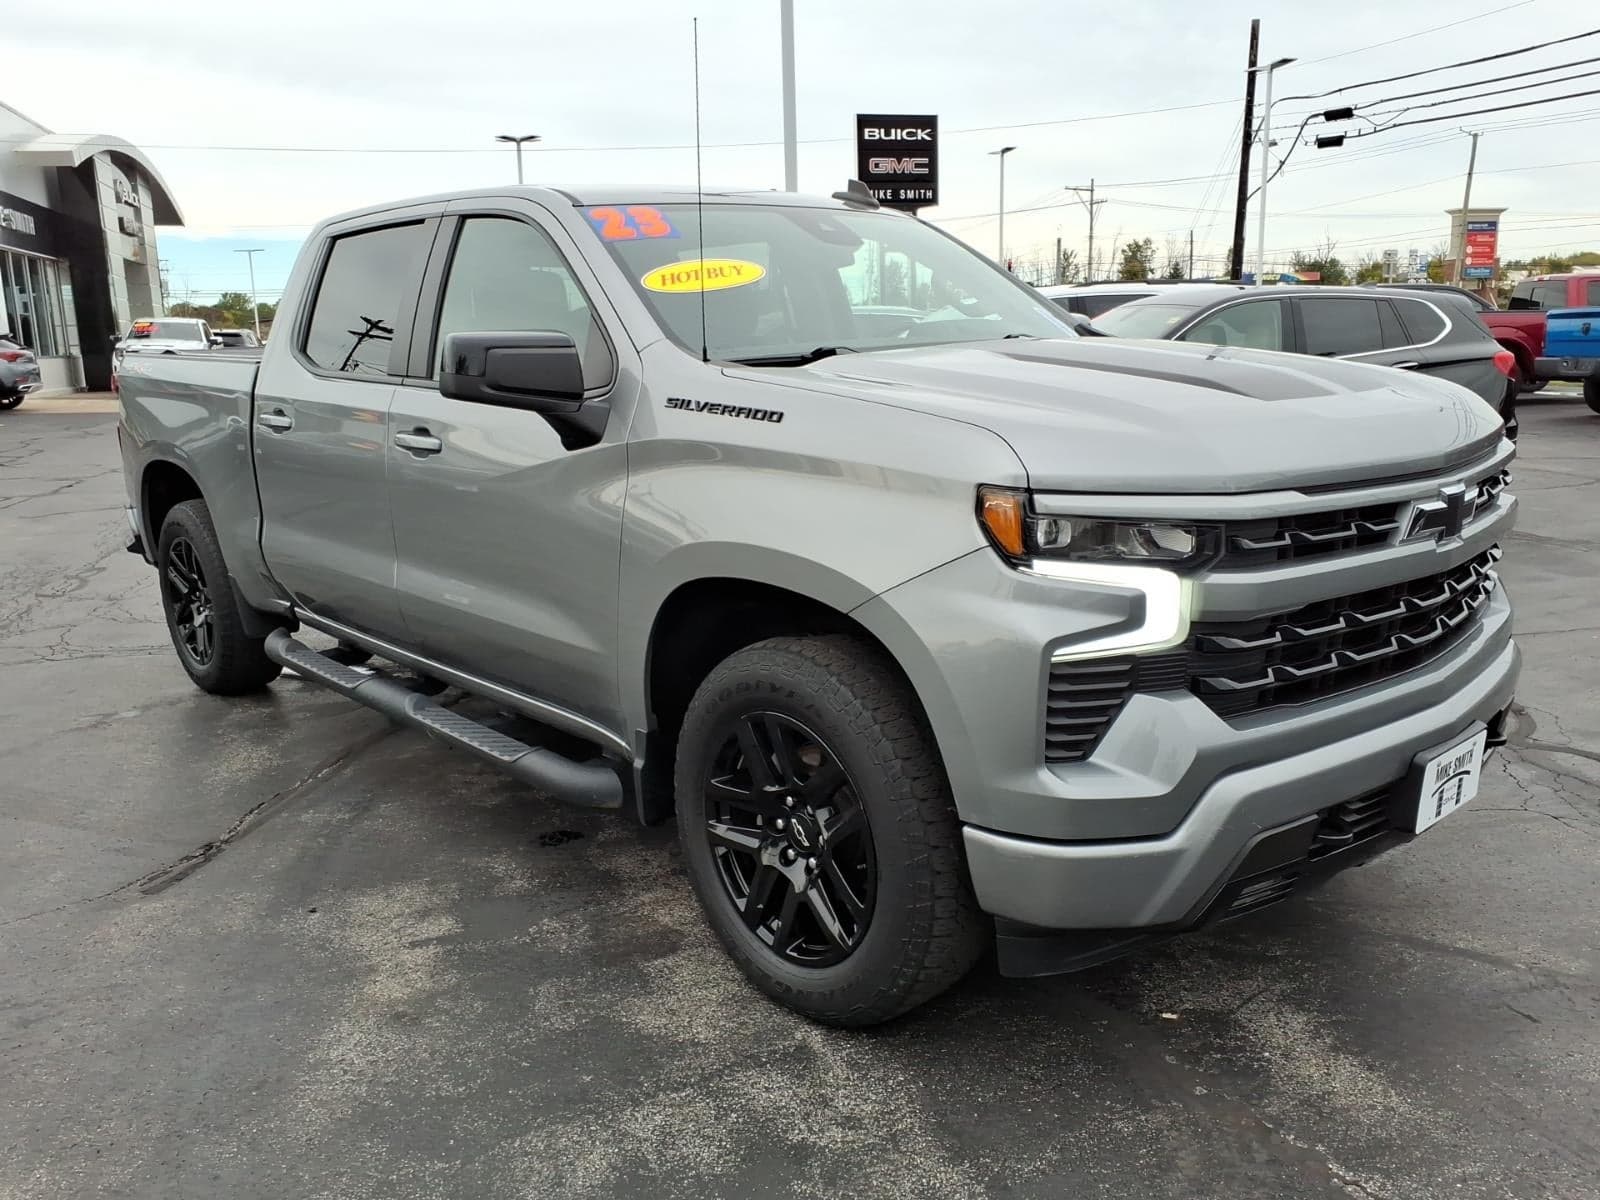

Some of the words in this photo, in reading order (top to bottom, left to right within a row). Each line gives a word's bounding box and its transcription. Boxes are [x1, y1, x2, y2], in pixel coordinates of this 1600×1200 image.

[864, 128, 932, 140] BUICK
[869, 158, 929, 173] GMC
[900, 189, 933, 199] SMITH
[588, 206, 671, 239] 23
[660, 269, 702, 287] HOT
[705, 265, 744, 279] BUY
[664, 397, 784, 423] SILVERADO
[1453, 749, 1474, 774] SMITH
